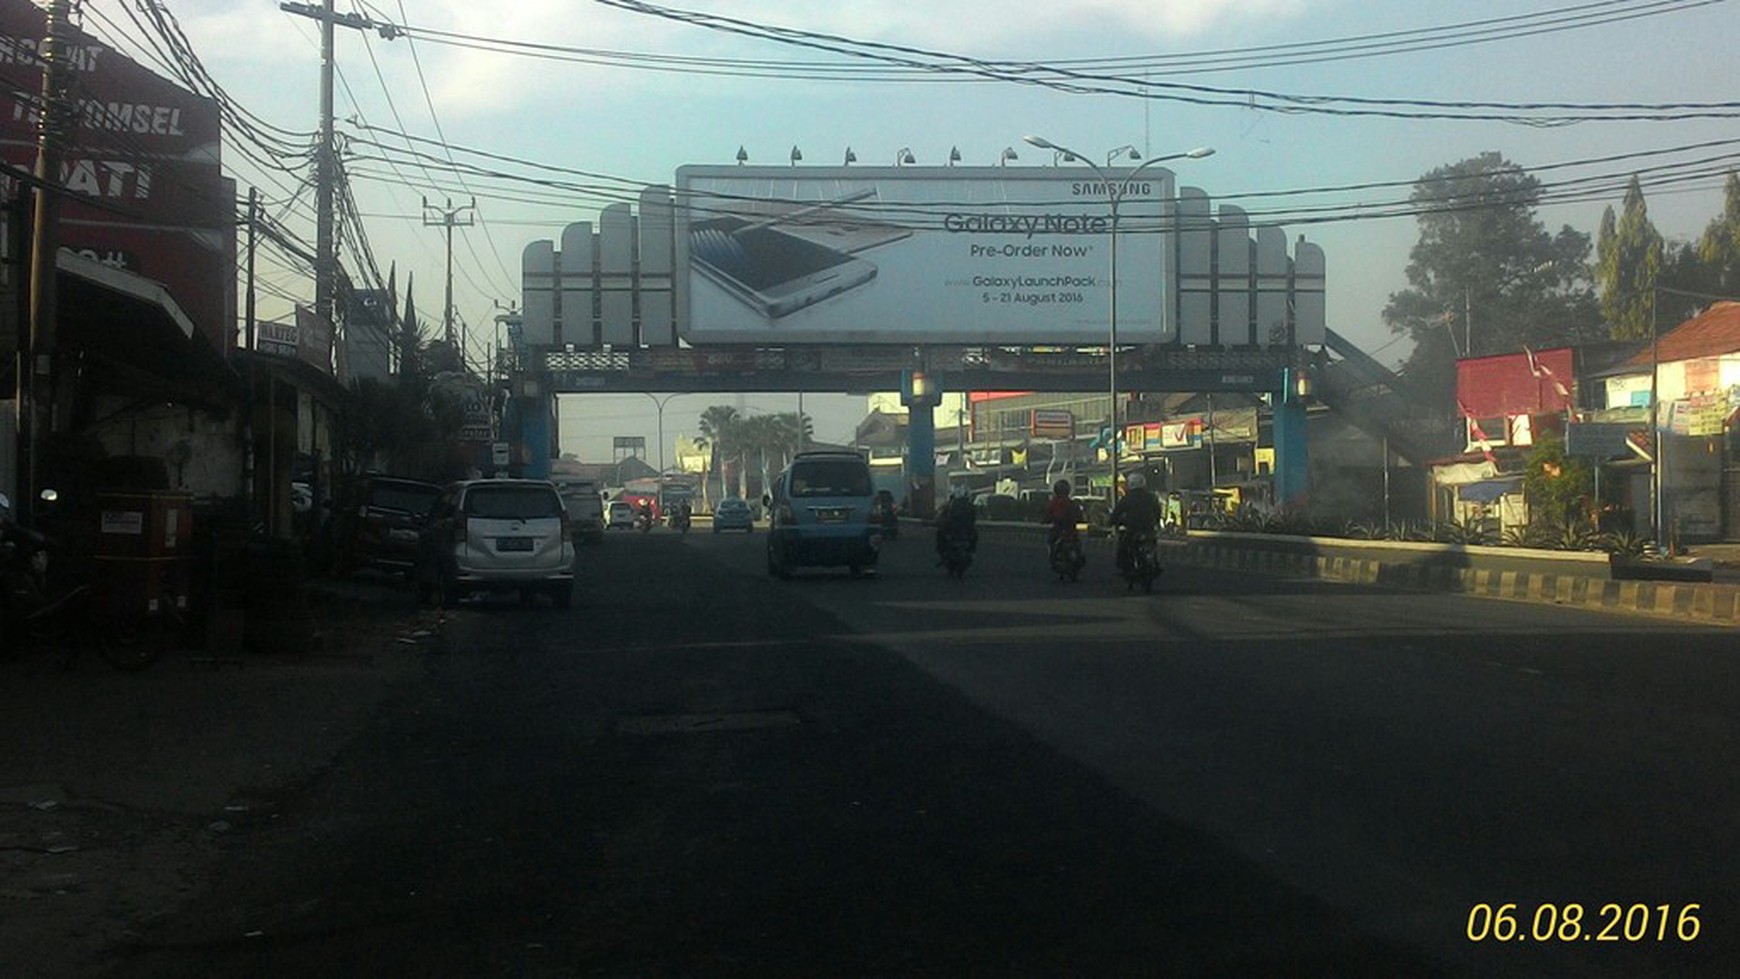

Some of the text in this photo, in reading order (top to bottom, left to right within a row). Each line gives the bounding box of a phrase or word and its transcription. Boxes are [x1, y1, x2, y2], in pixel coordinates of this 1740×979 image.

[1072, 182, 1151, 196] SAMSUNG
[944, 212, 1038, 240] Galaxy
[970, 244, 1048, 257] Pre-Order
[982, 293, 990, 304] 5
[1000, 293, 1011, 303] 21
[1014, 292, 1056, 306] August
[1058, 292, 1084, 303] 2016
